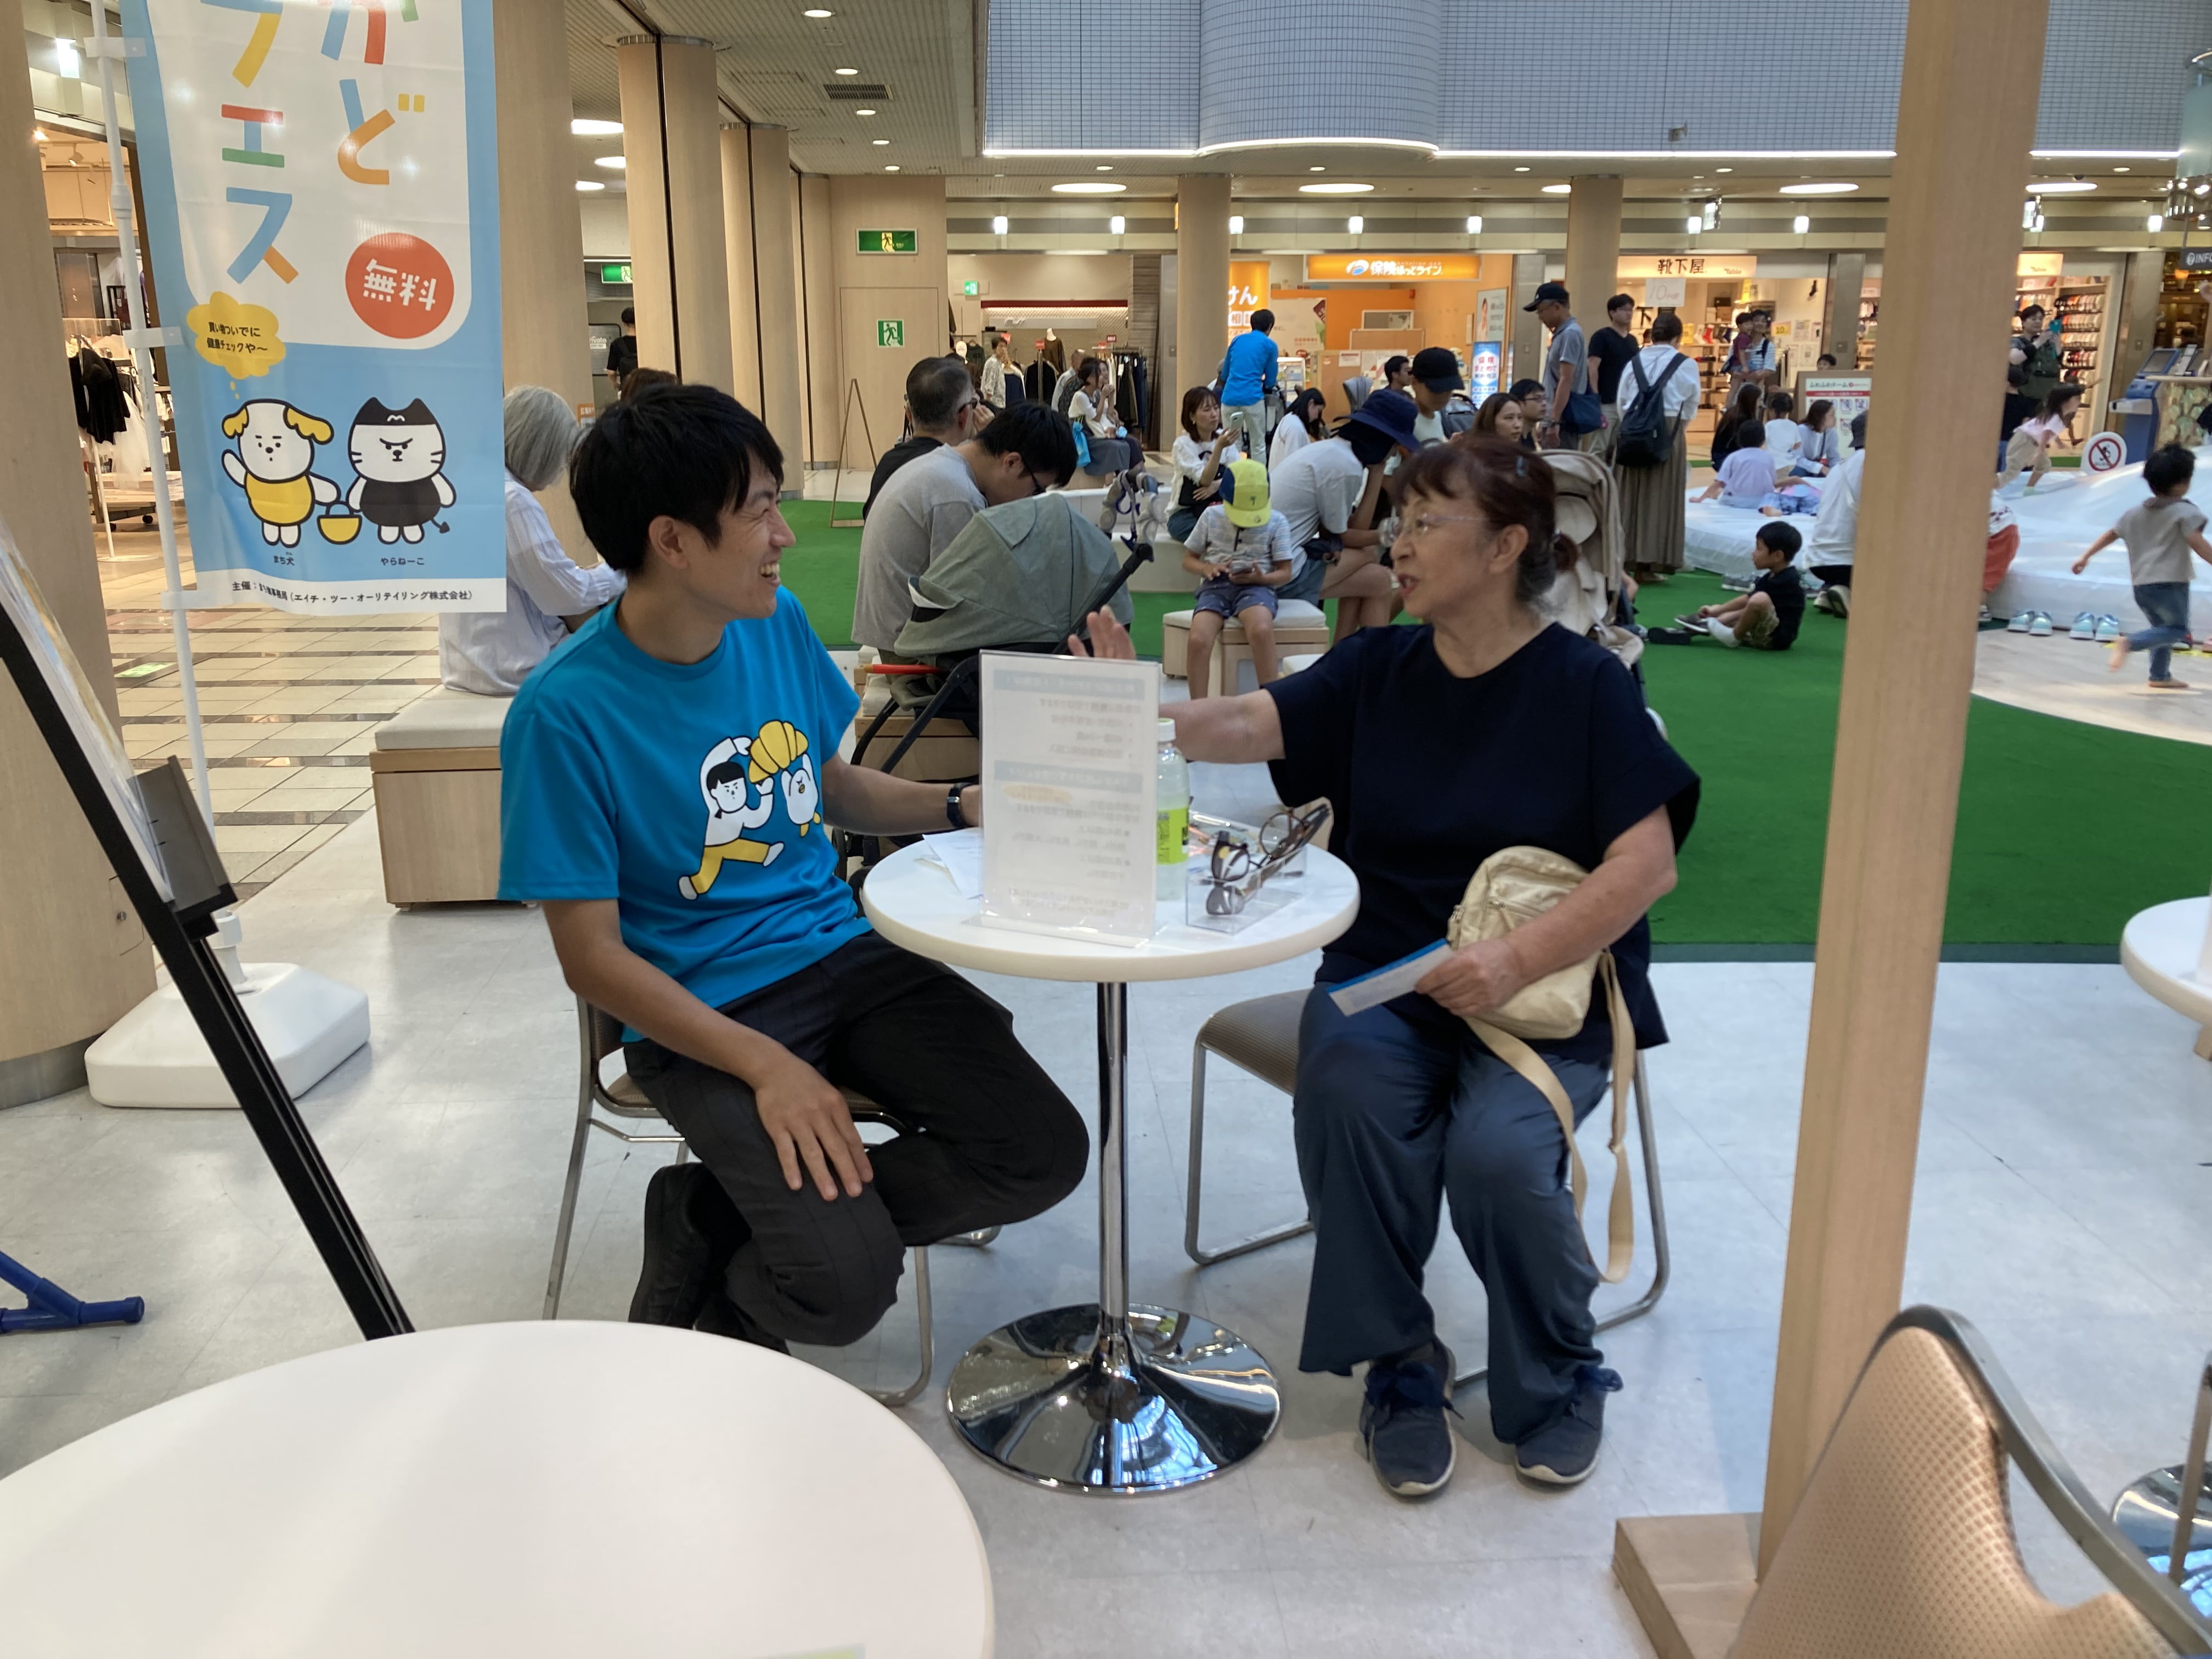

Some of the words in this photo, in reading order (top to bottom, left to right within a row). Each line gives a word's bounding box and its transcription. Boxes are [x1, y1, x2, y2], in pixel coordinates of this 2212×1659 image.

[1658, 258, 1705, 274] 靴下屋
[363, 258, 437, 311] 無料
[589, 335, 607, 344] rivate
[273, 555, 295, 566] まち犬
[381, 557, 425, 566] やらねーこ
